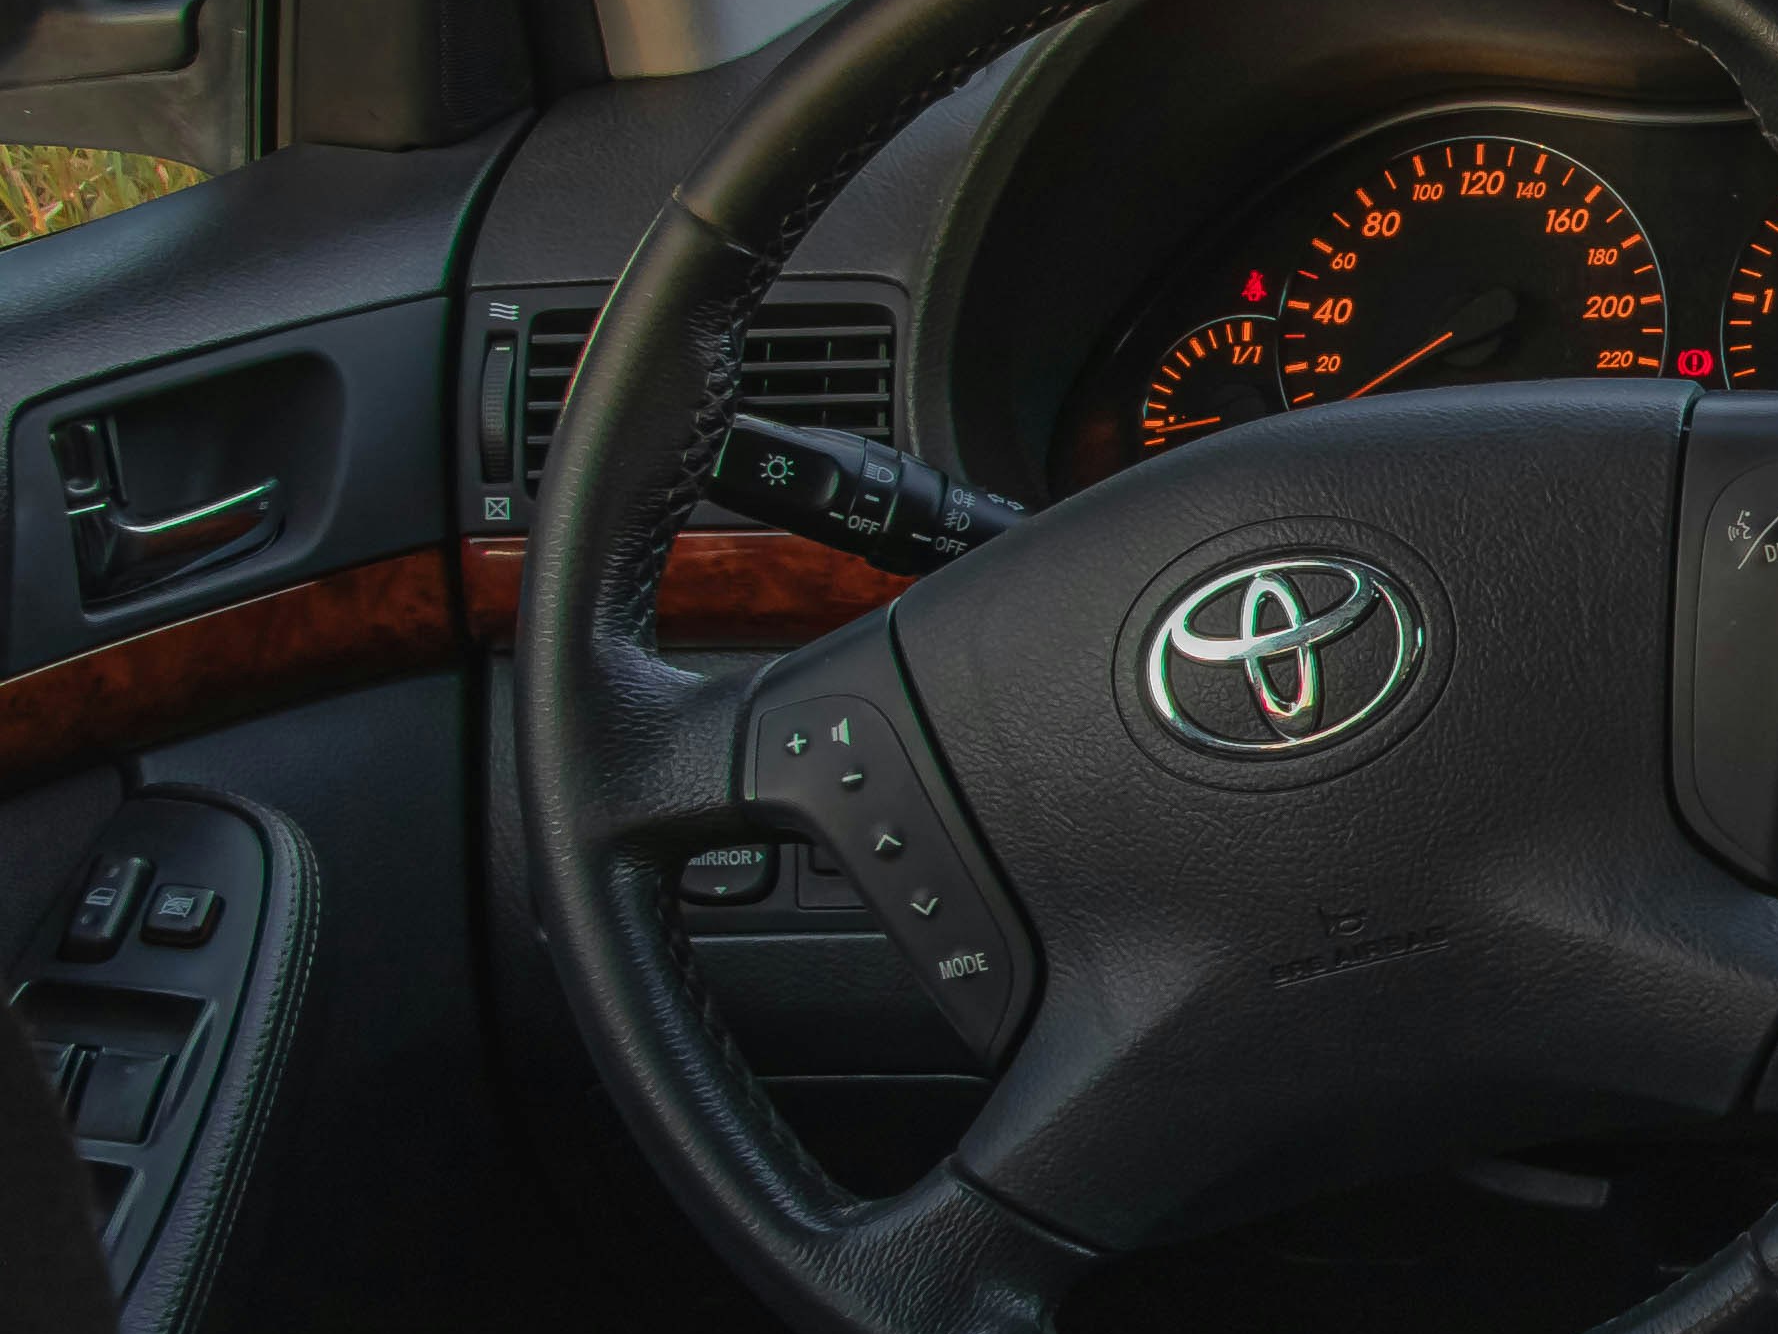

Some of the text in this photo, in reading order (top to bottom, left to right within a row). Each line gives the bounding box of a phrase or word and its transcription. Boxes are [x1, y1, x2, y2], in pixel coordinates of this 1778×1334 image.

[1412, 183, 1443, 201] 100
[1460, 170, 1505, 196] 120
[1516, 181, 1547, 200] 140
[1362, 211, 1401, 237] 80
[1545, 208, 1589, 234] 160
[1332, 252, 1357, 270] 60
[1587, 248, 1618, 267] 180
[1313, 298, 1353, 324] 40
[1583, 295, 1635, 319] 200
[1762, 288, 1773, 315] 1
[1232, 345, 1263, 365] 1/1
[1315, 355, 1341, 373] 20
[1597, 351, 1633, 369] 220
[847, 514, 880, 535] OFF
[935, 535, 968, 555] OFF
[939, 953, 988, 979] MODE
